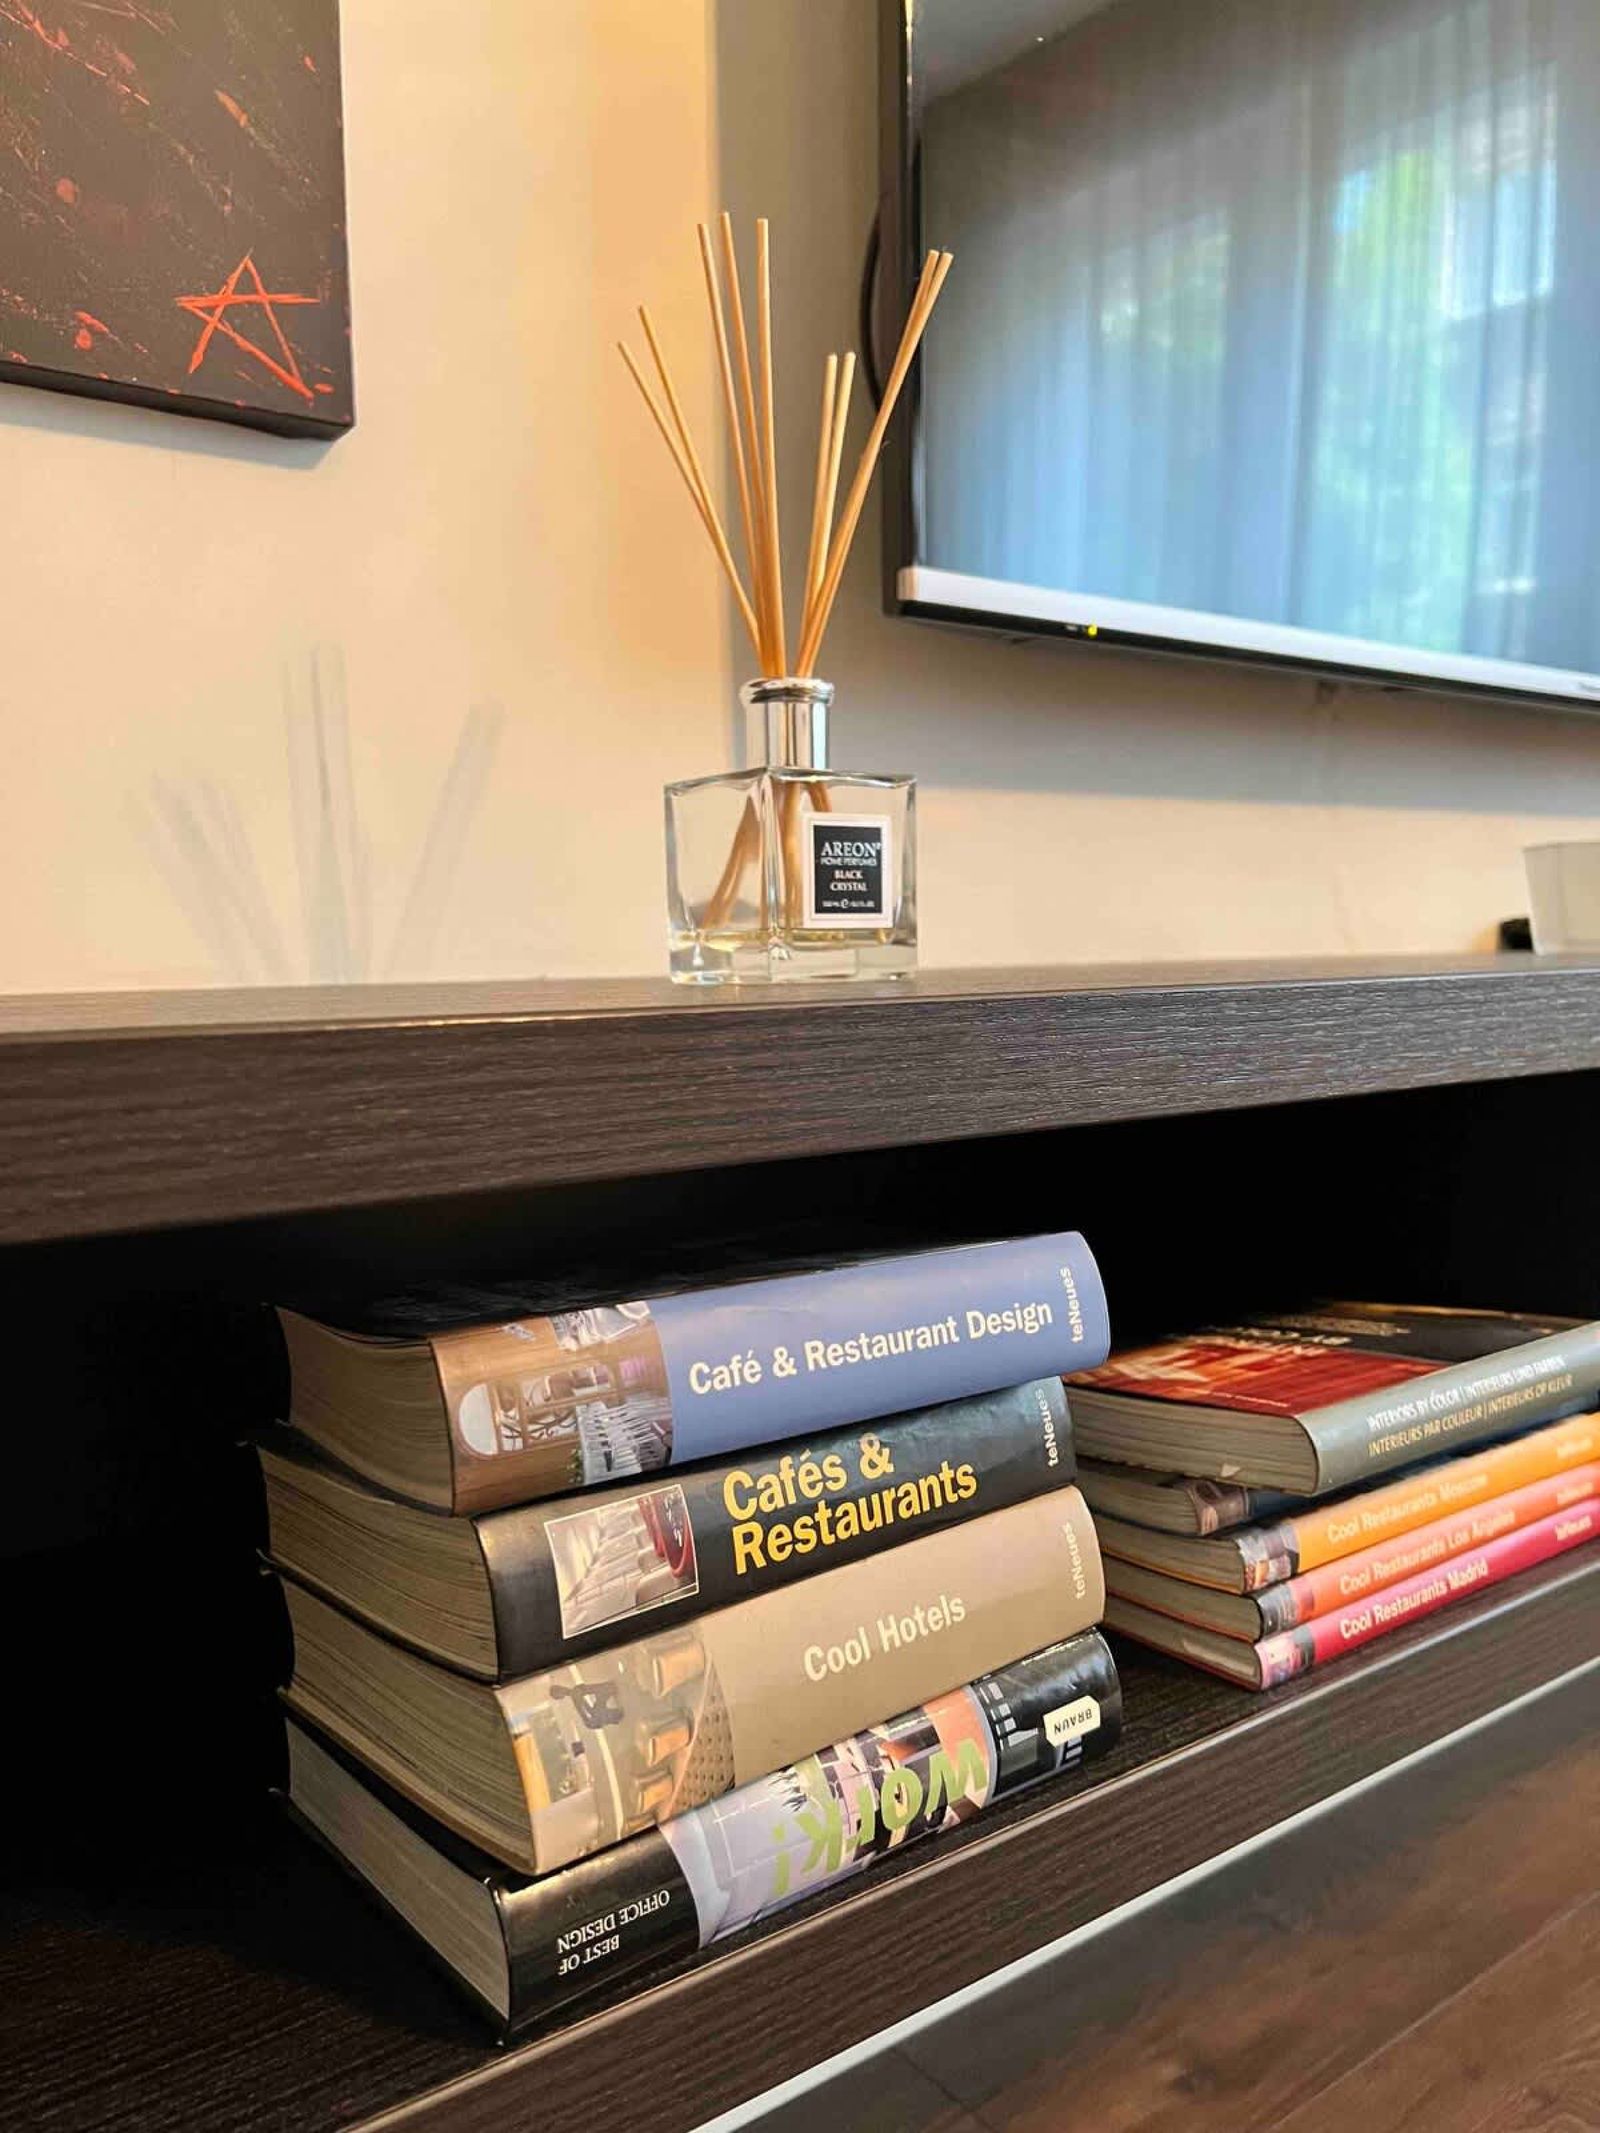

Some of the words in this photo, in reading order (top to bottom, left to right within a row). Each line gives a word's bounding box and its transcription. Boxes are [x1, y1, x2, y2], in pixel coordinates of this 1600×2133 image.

[821, 842, 879, 857] AREON
[834, 870, 863, 879] BLACK
[830, 882, 867, 891] CRYSTAL
[1059, 1267, 1085, 1343] teNeues
[688, 1349, 763, 1395] Café
[772, 1346, 797, 1379] &
[804, 1317, 960, 1371] Restaurant
[965, 1302, 1053, 1341] Design
[1035, 1388, 1060, 1467] teNeues
[1441, 1404, 1484, 1433] COULEUR
[723, 1448, 848, 1521] Cafés
[858, 1432, 895, 1479] &
[732, 1461, 978, 1575] Restaurants
[1327, 1519, 1361, 1544] Cool
[1361, 1492, 1438, 1533] Restaurants
[1062, 1523, 1087, 1600] teNeues
[1338, 1569, 1371, 1595] Cool
[1373, 1541, 1447, 1580] Restaurants
[1340, 1613, 1372, 1640] Cool
[1374, 1581, 1448, 1625] Restaurants
[1448, 1559, 1489, 1592] Madrid
[803, 1626, 871, 1682] Cool
[876, 1593, 967, 1653] Hotels
[1052, 1708, 1093, 1735] BRAUN
[556, 1912, 617, 1954] DESIGN
[619, 1889, 671, 1925] OFFICE
[558, 1954, 581, 1976] OF
[582, 1934, 620, 1965] BEST
